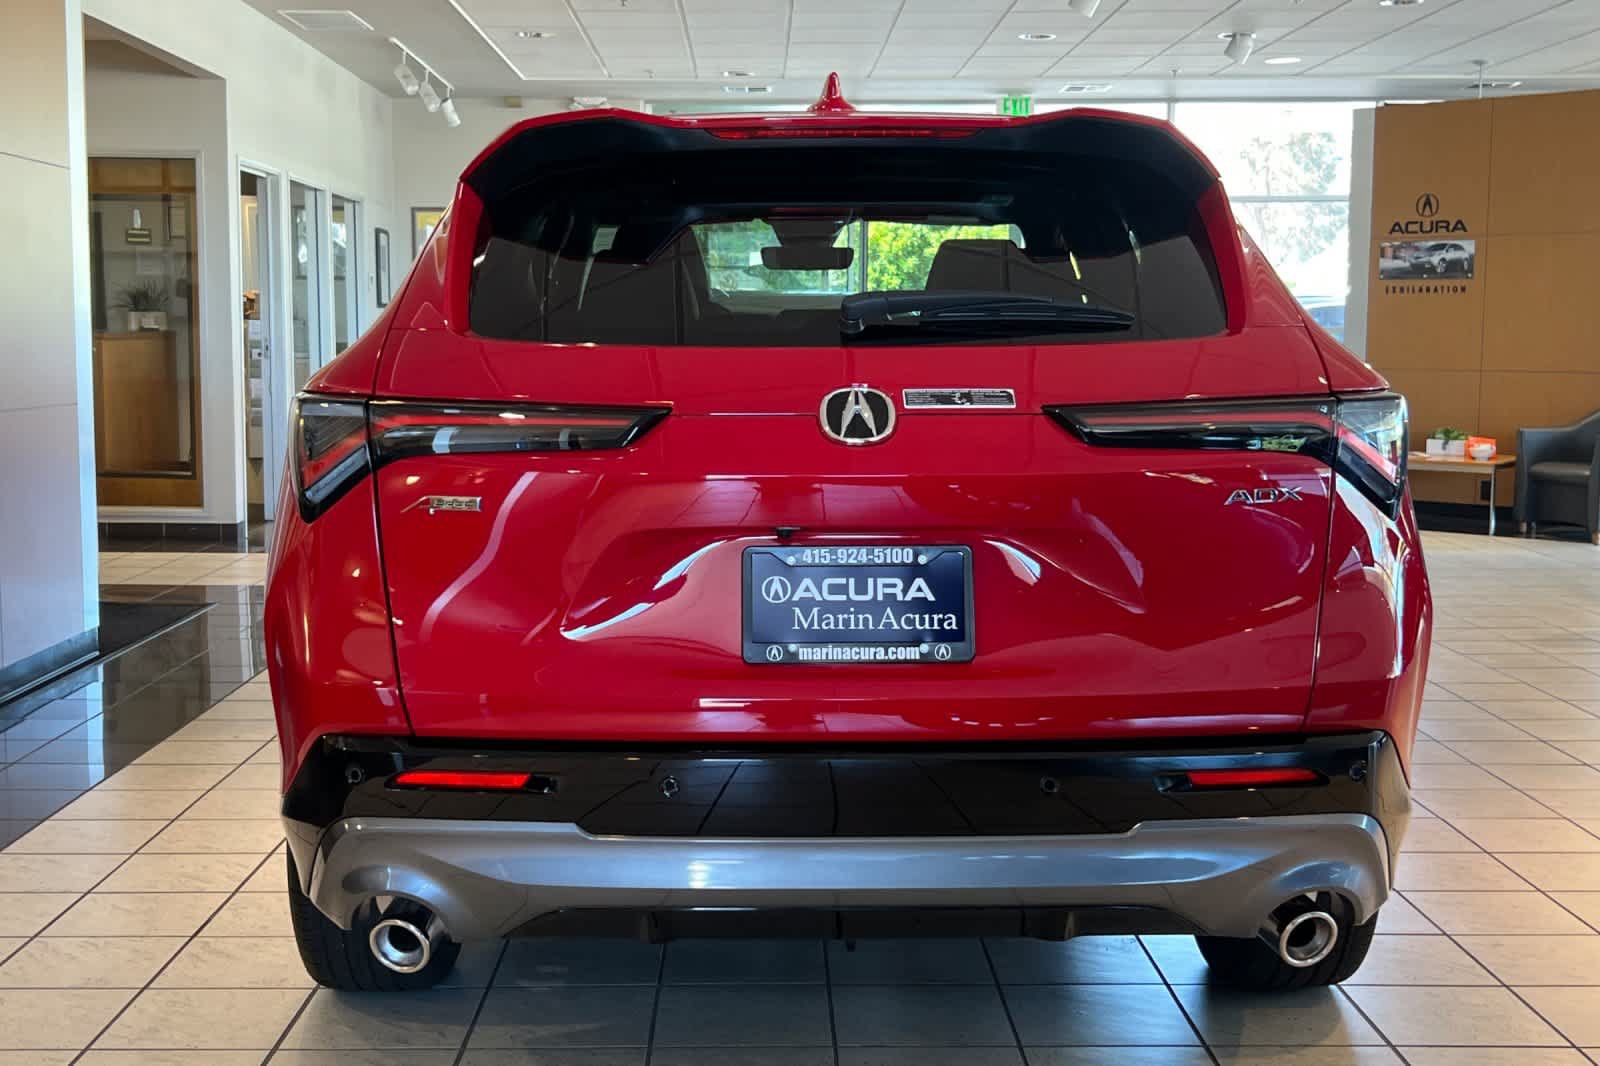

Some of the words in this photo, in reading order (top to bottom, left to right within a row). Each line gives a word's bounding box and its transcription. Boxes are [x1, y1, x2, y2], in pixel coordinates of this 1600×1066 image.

[1003, 96, 1031, 116] EXIT
[1388, 219, 1468, 235] ACURA
[1224, 487, 1303, 505] ADX
[802, 548, 913, 564] 415-924-5100
[792, 577, 936, 601] ACURA
[792, 607, 879, 630] Marin
[880, 607, 958, 630] Acura
[799, 644, 920, 660] marinacura.com
